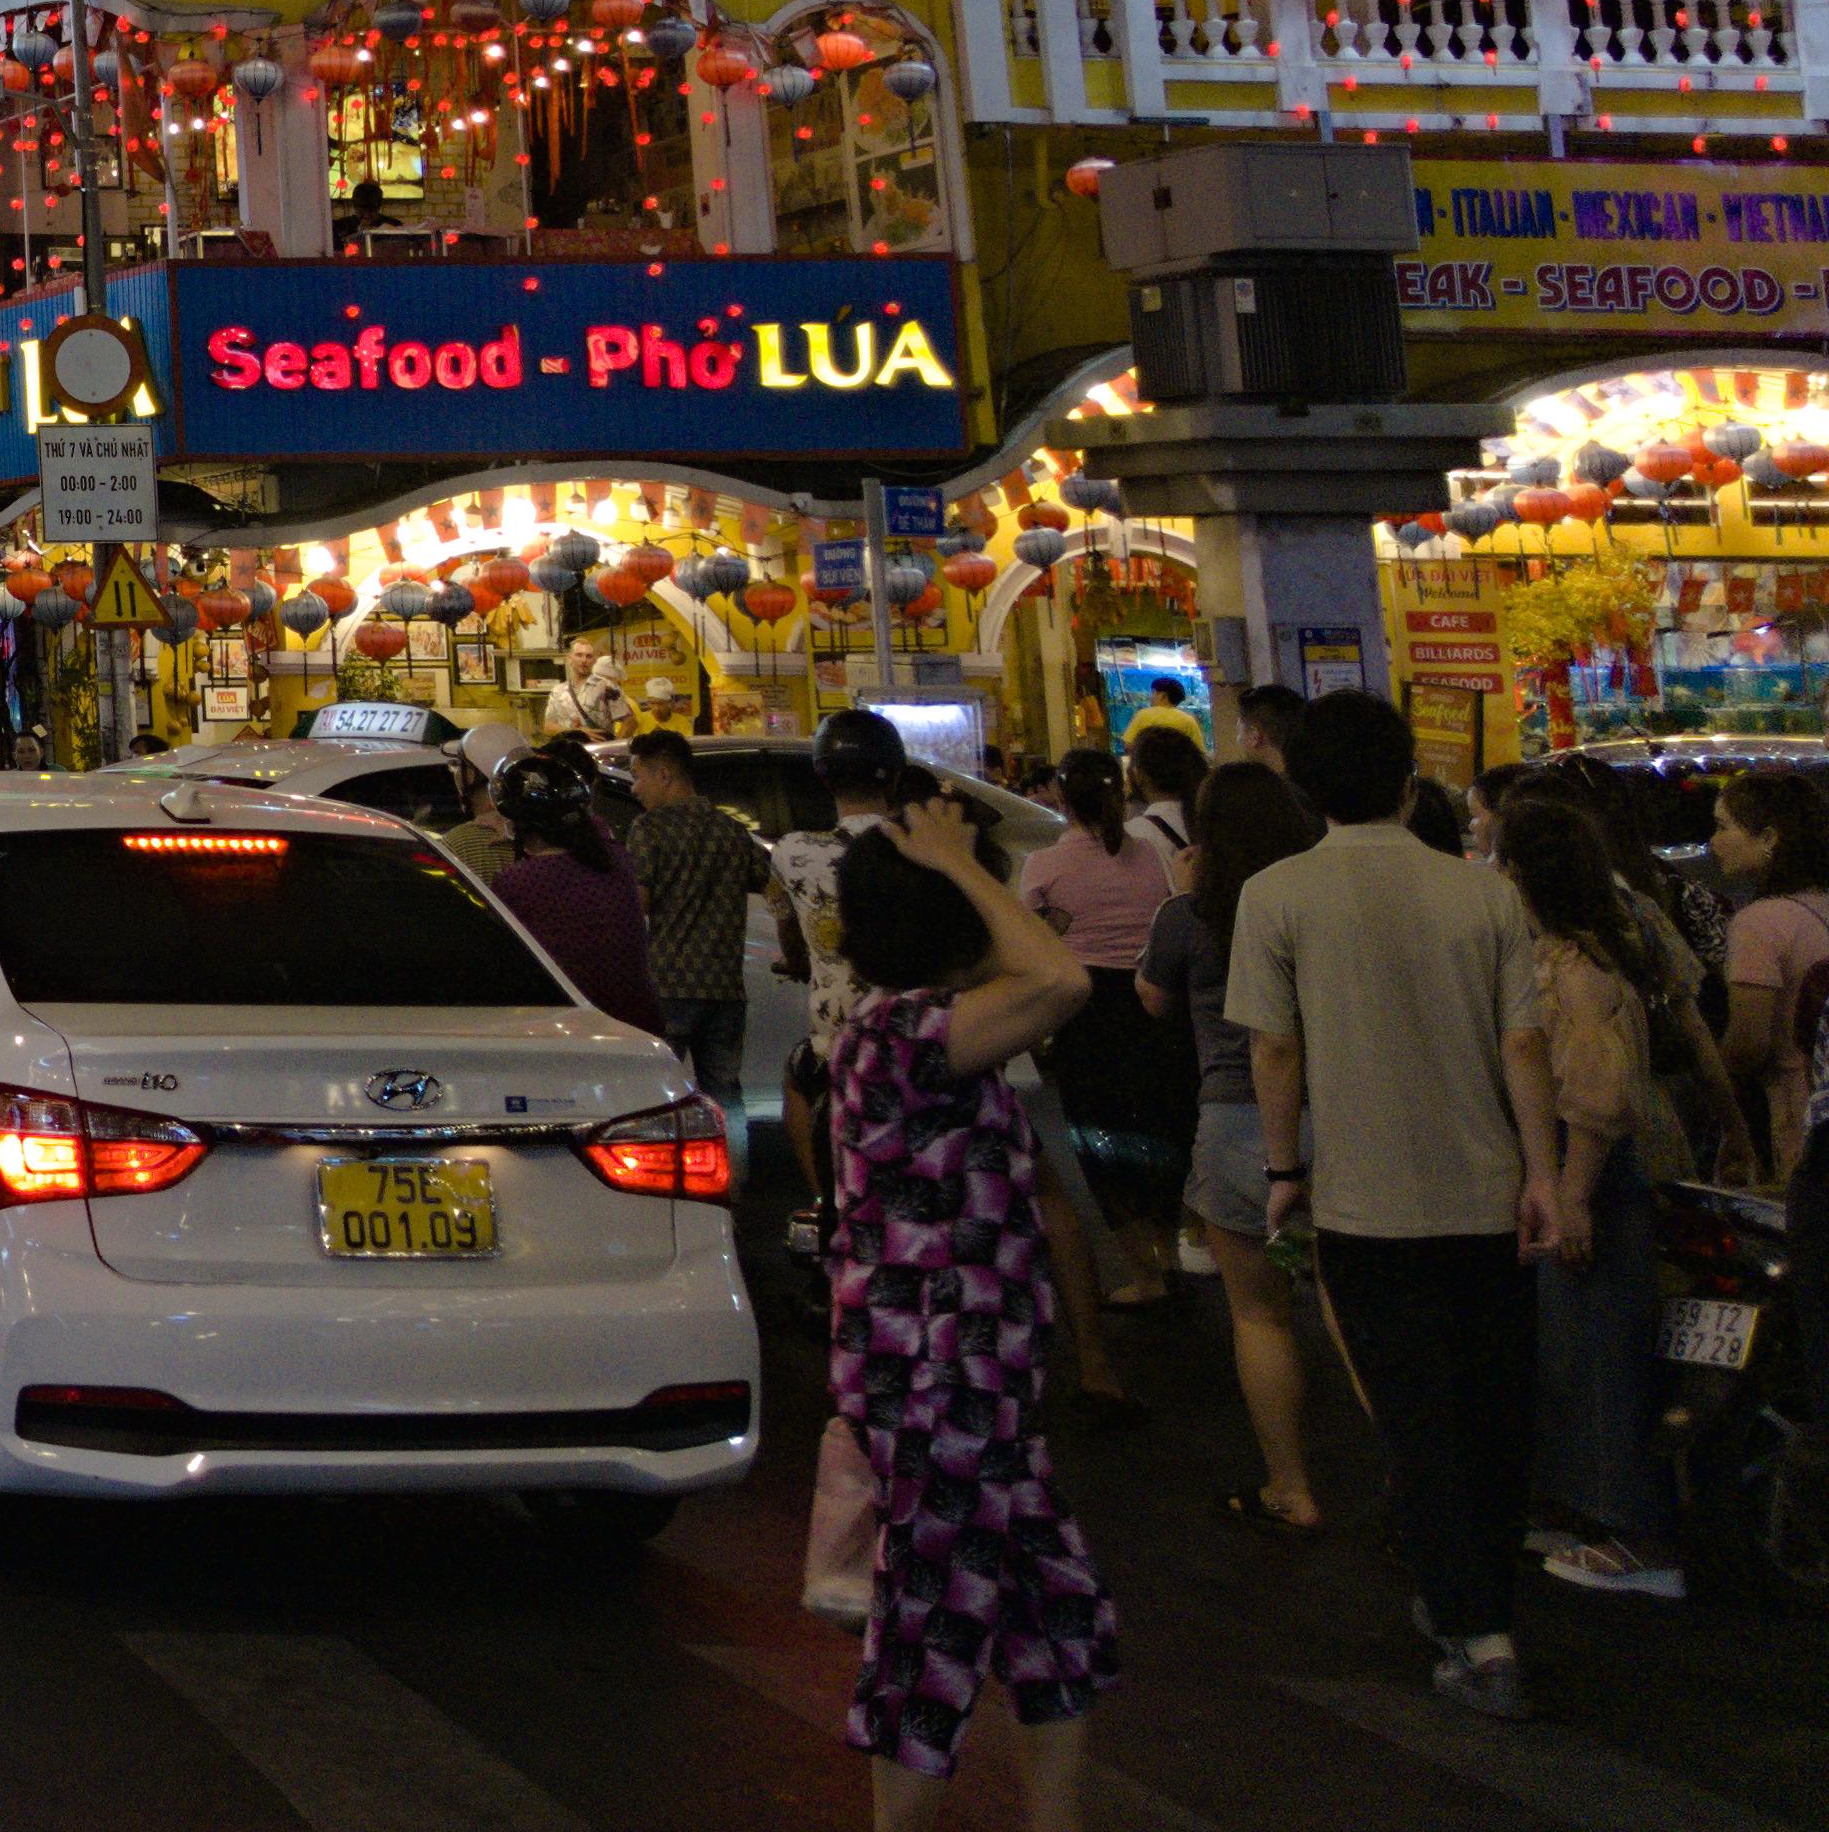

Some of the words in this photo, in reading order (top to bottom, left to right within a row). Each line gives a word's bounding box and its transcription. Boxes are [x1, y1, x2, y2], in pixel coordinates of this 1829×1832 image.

[1450, 188, 1557, 239] ITALIAN
[1572, 188, 1701, 243] MEXICAN
[1535, 262, 1786, 316] SEAFOOD
[207, 323, 523, 390] Seafood
[586, 317, 743, 390] Phở
[752, 306, 955, 390] LÚA
[44, 438, 66, 458] THỨ
[69, 443, 76, 458] 7
[79, 438, 94, 459] VÀ
[96, 438, 118, 459] CHỦ
[121, 438, 150, 462] NHẬT
[60, 475, 96, 492] 00:00
[110, 474, 137, 491] 2:00
[58, 508, 92, 525] 19:00
[107, 508, 143, 525] 24:00
[1430, 615, 1470, 629] CAFE
[1415, 647, 1495, 661] BILLIARDS
[368, 1165, 443, 1205] 75E
[343, 1209, 479, 1251] 001.09
